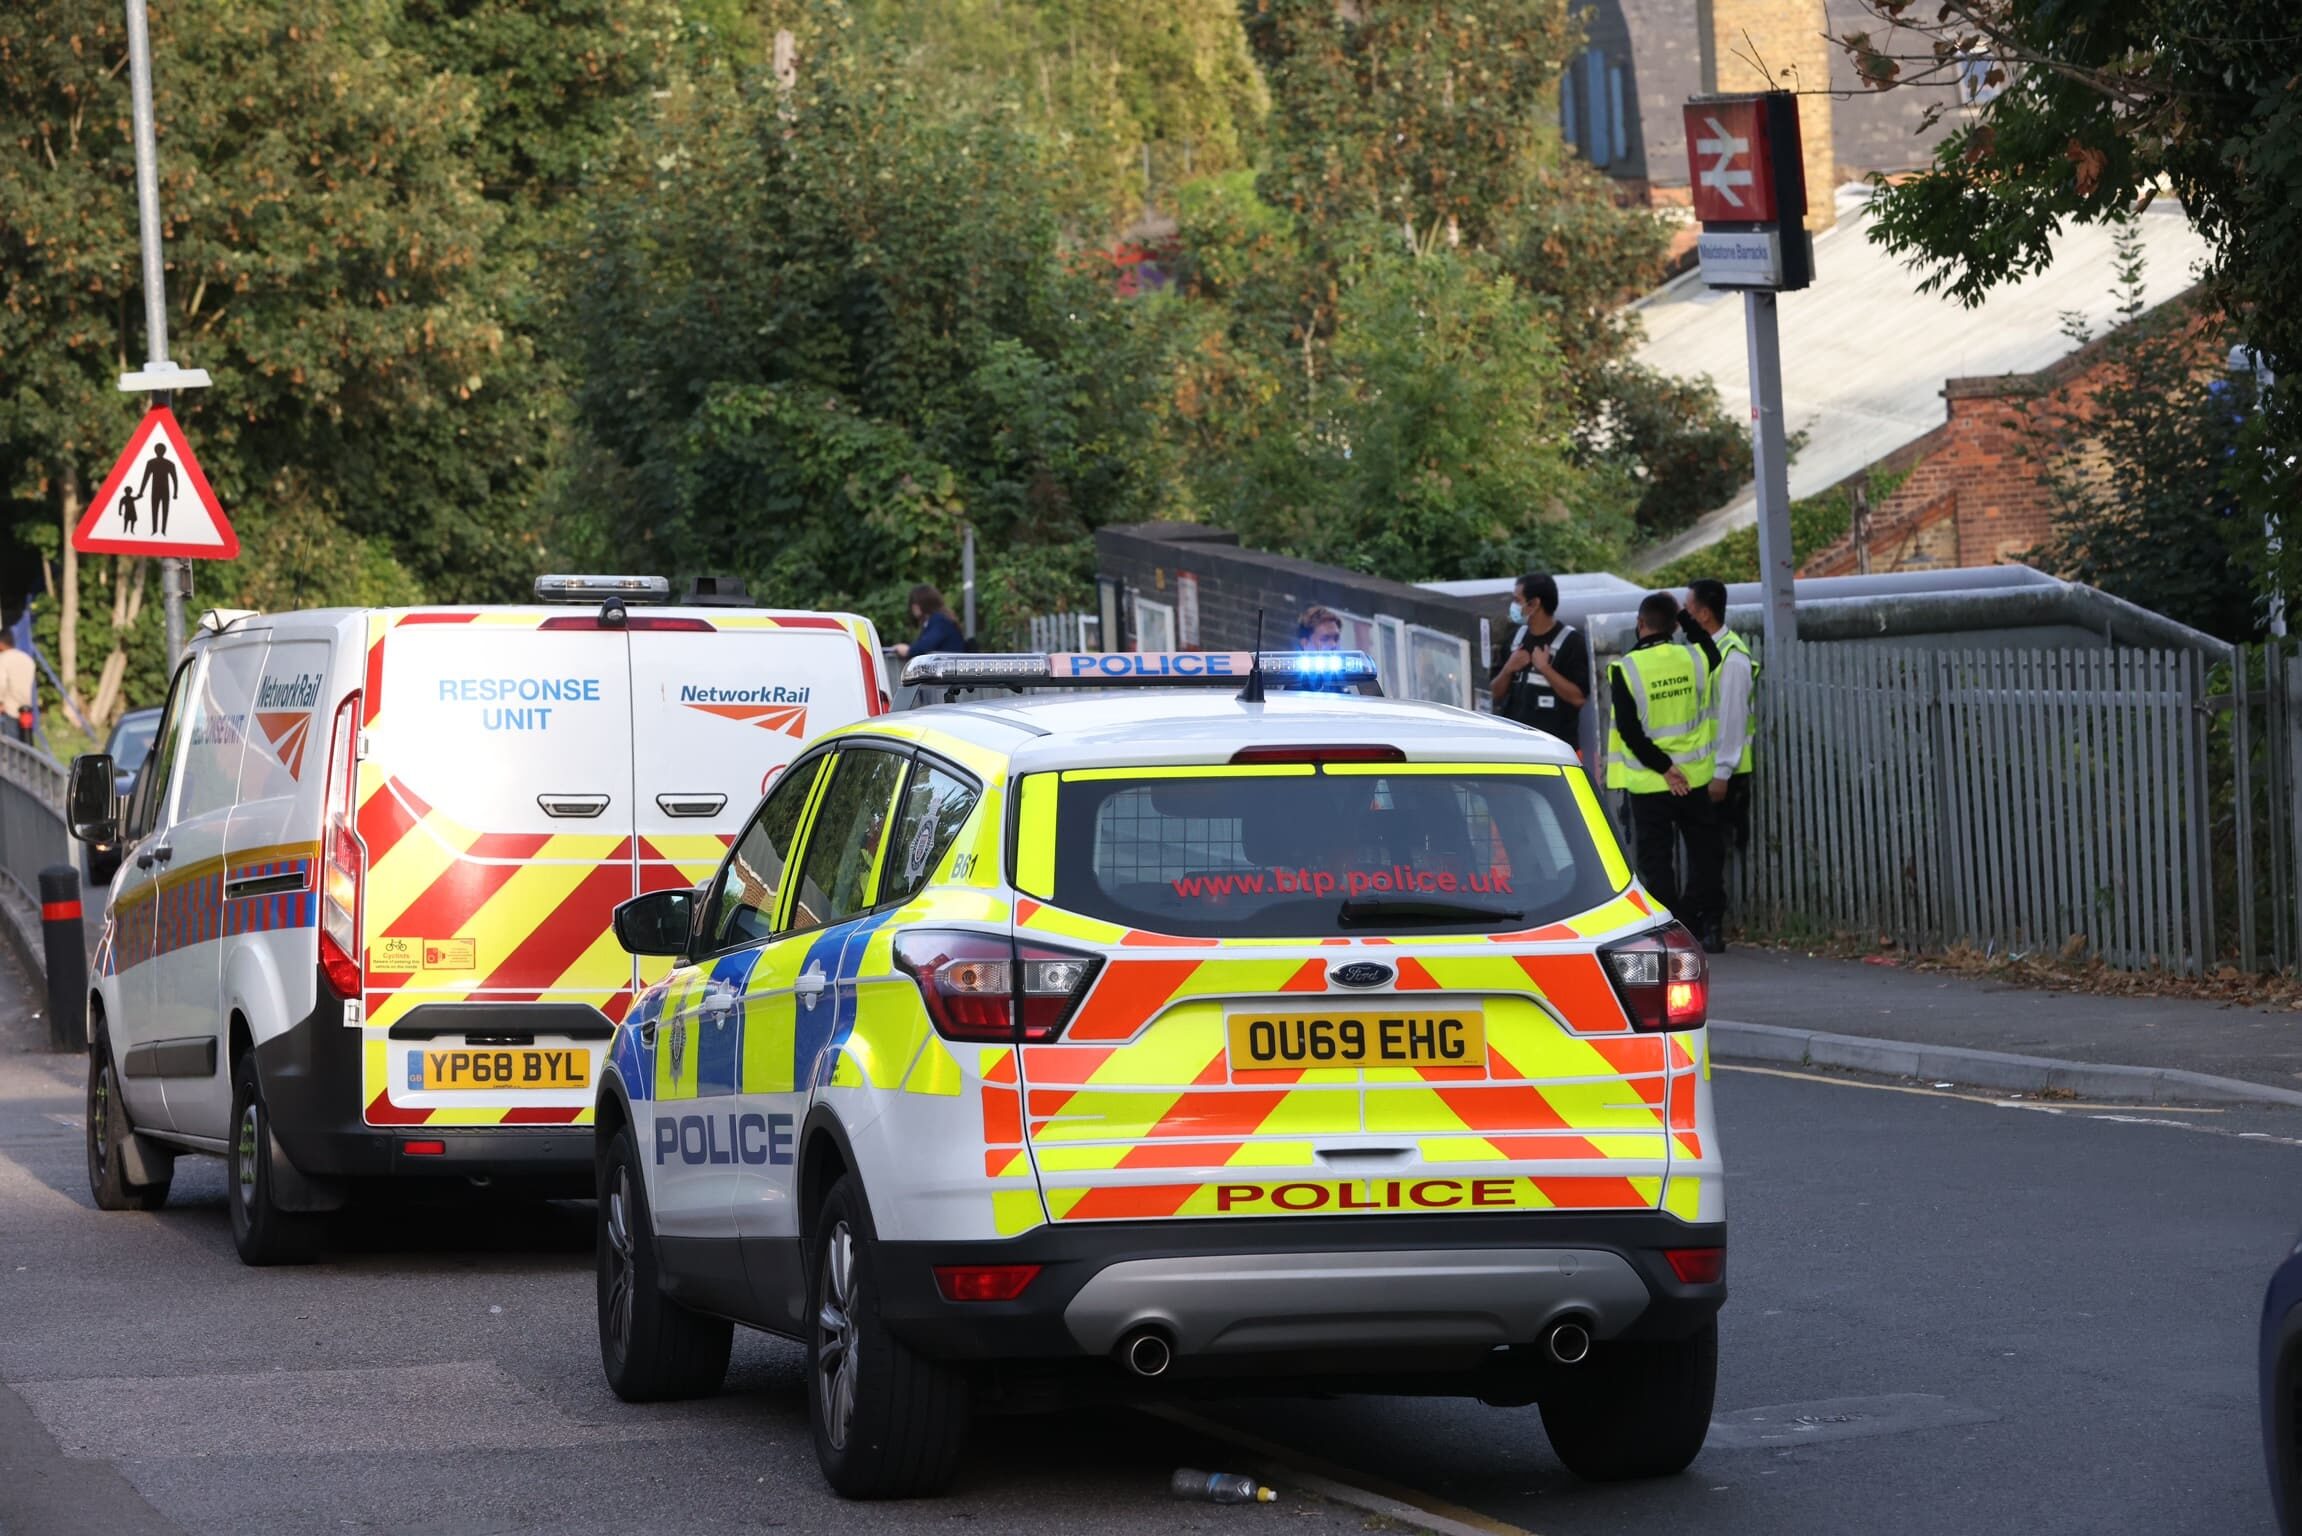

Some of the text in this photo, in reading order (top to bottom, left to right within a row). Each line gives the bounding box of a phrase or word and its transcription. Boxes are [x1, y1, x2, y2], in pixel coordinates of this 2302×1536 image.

[1735, 243, 1769, 259] Barracks
[1071, 655, 1233, 676] POLICE
[257, 673, 322, 708] NetworkRail
[439, 679, 600, 701] RESPONSE
[1651, 675, 1689, 688] STATION
[680, 684, 810, 704] NetworkRail
[1650, 687, 1693, 702] SECURITY
[483, 709, 552, 730] UNIT
[951, 853, 979, 879] B61
[1171, 864, 1514, 899] www.btp.police.uk
[1345, 966, 1379, 982] Ford
[1249, 1019, 1465, 1061] OU69 EHG
[430, 1052, 584, 1082] YP68 BYL
[409, 1074, 422, 1082] GB
[655, 1113, 794, 1166] POLICE
[1217, 1179, 1516, 1212] POLICE
